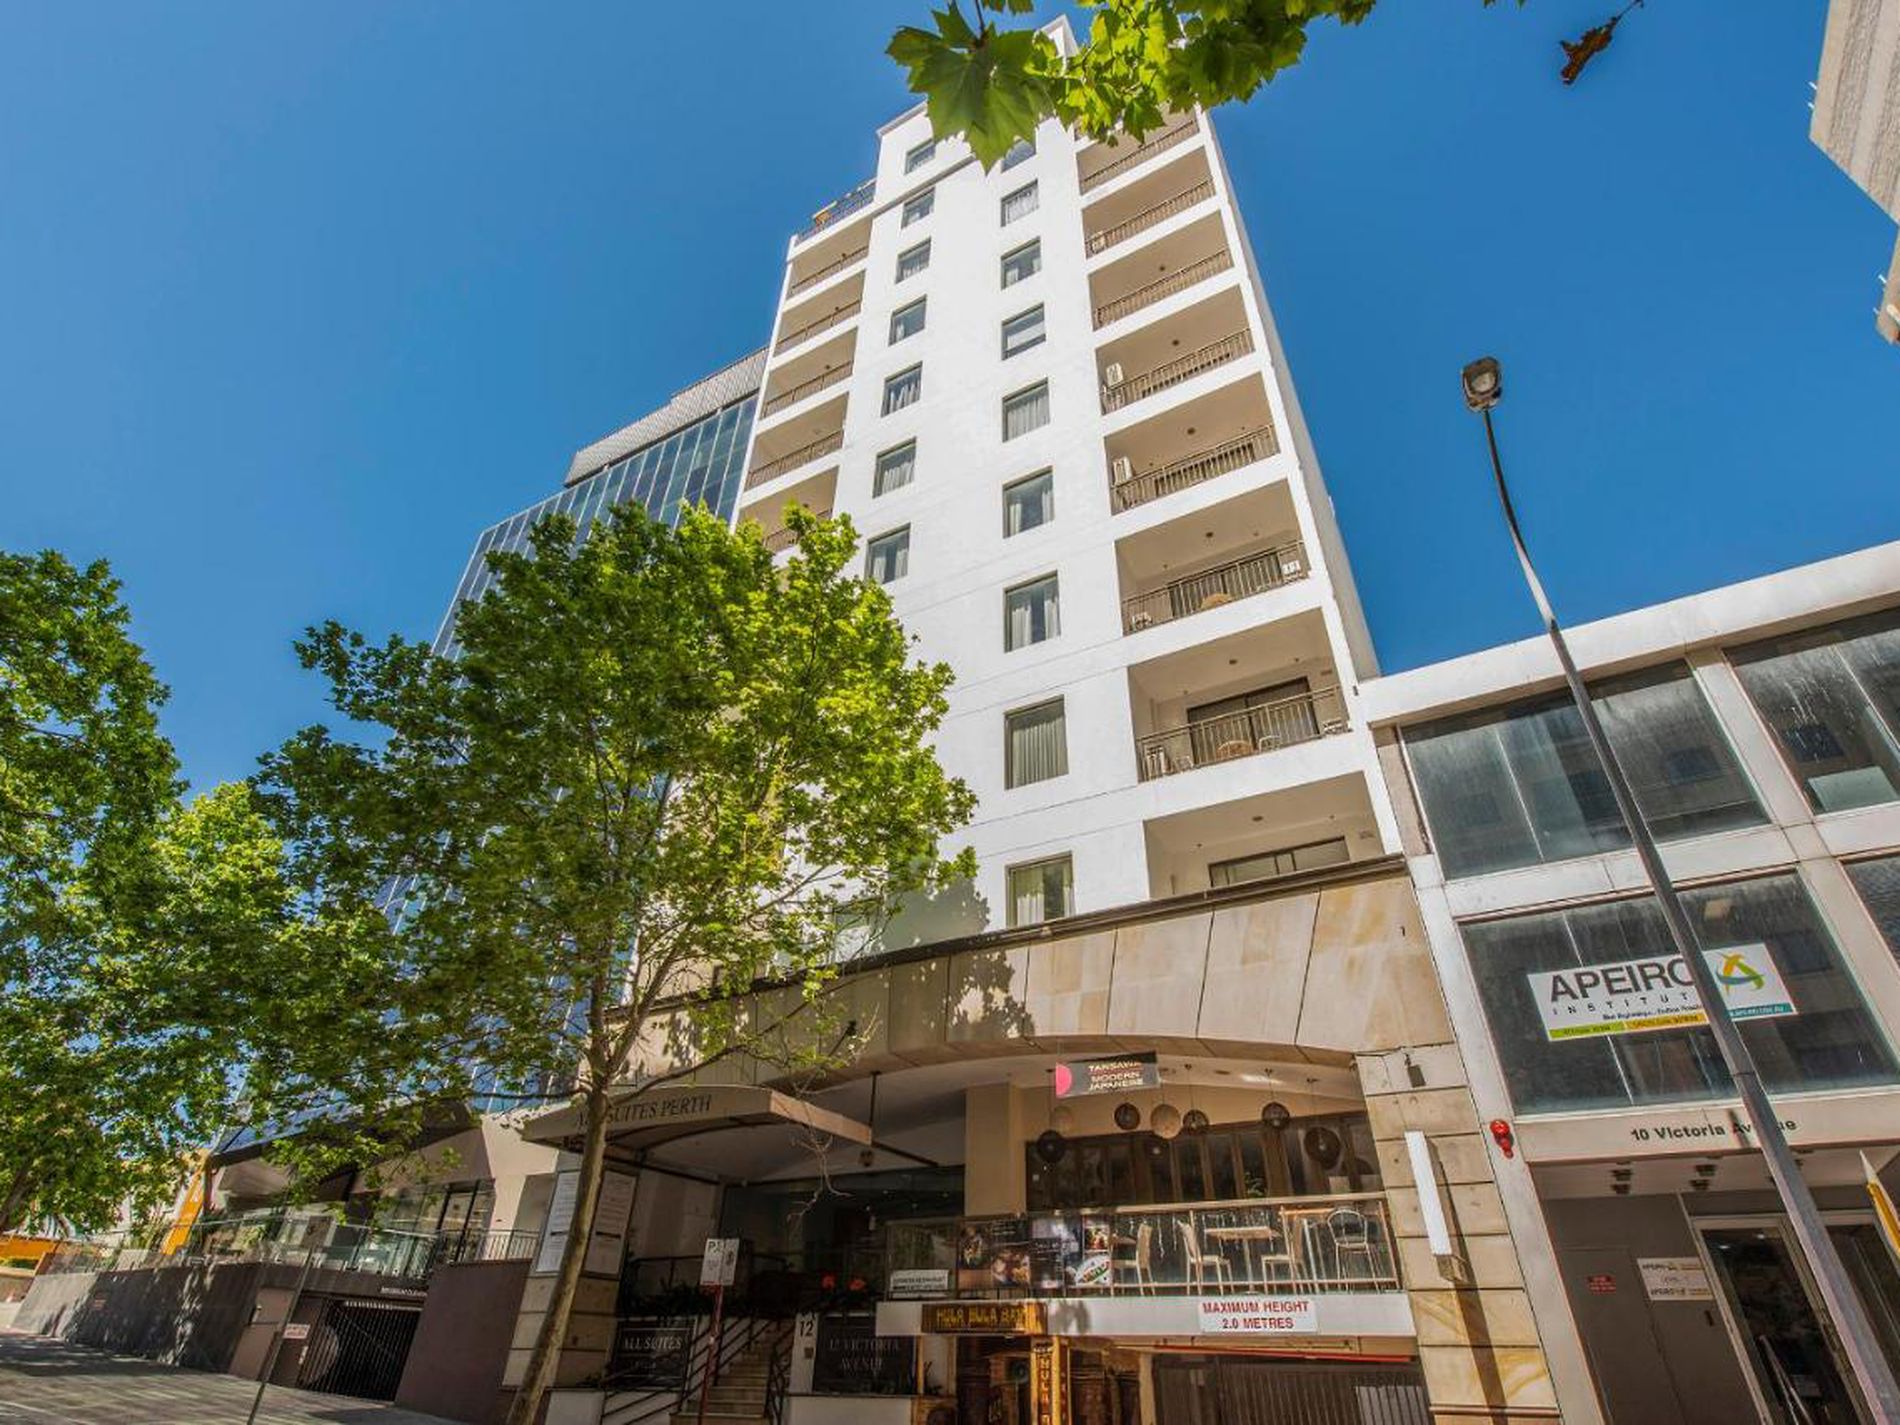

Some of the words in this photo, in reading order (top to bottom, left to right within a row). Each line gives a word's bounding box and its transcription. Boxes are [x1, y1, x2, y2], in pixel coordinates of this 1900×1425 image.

[1550, 957, 1695, 1002] APEIRO
[1553, 992, 1690, 1016] INSTITUT
[660, 1094, 712, 1117] PERTH
[1631, 1128, 1649, 1141] 10
[1654, 1123, 1726, 1139] Victoria
[1732, 1120, 1797, 1135] Avue
[1203, 1301, 1259, 1314] MAXIMUM
[1264, 1301, 1309, 1313] HEIGHT
[800, 1320, 814, 1336] 12
[1222, 1318, 1239, 1330] 2.0
[1243, 1317, 1294, 1330] METRES
